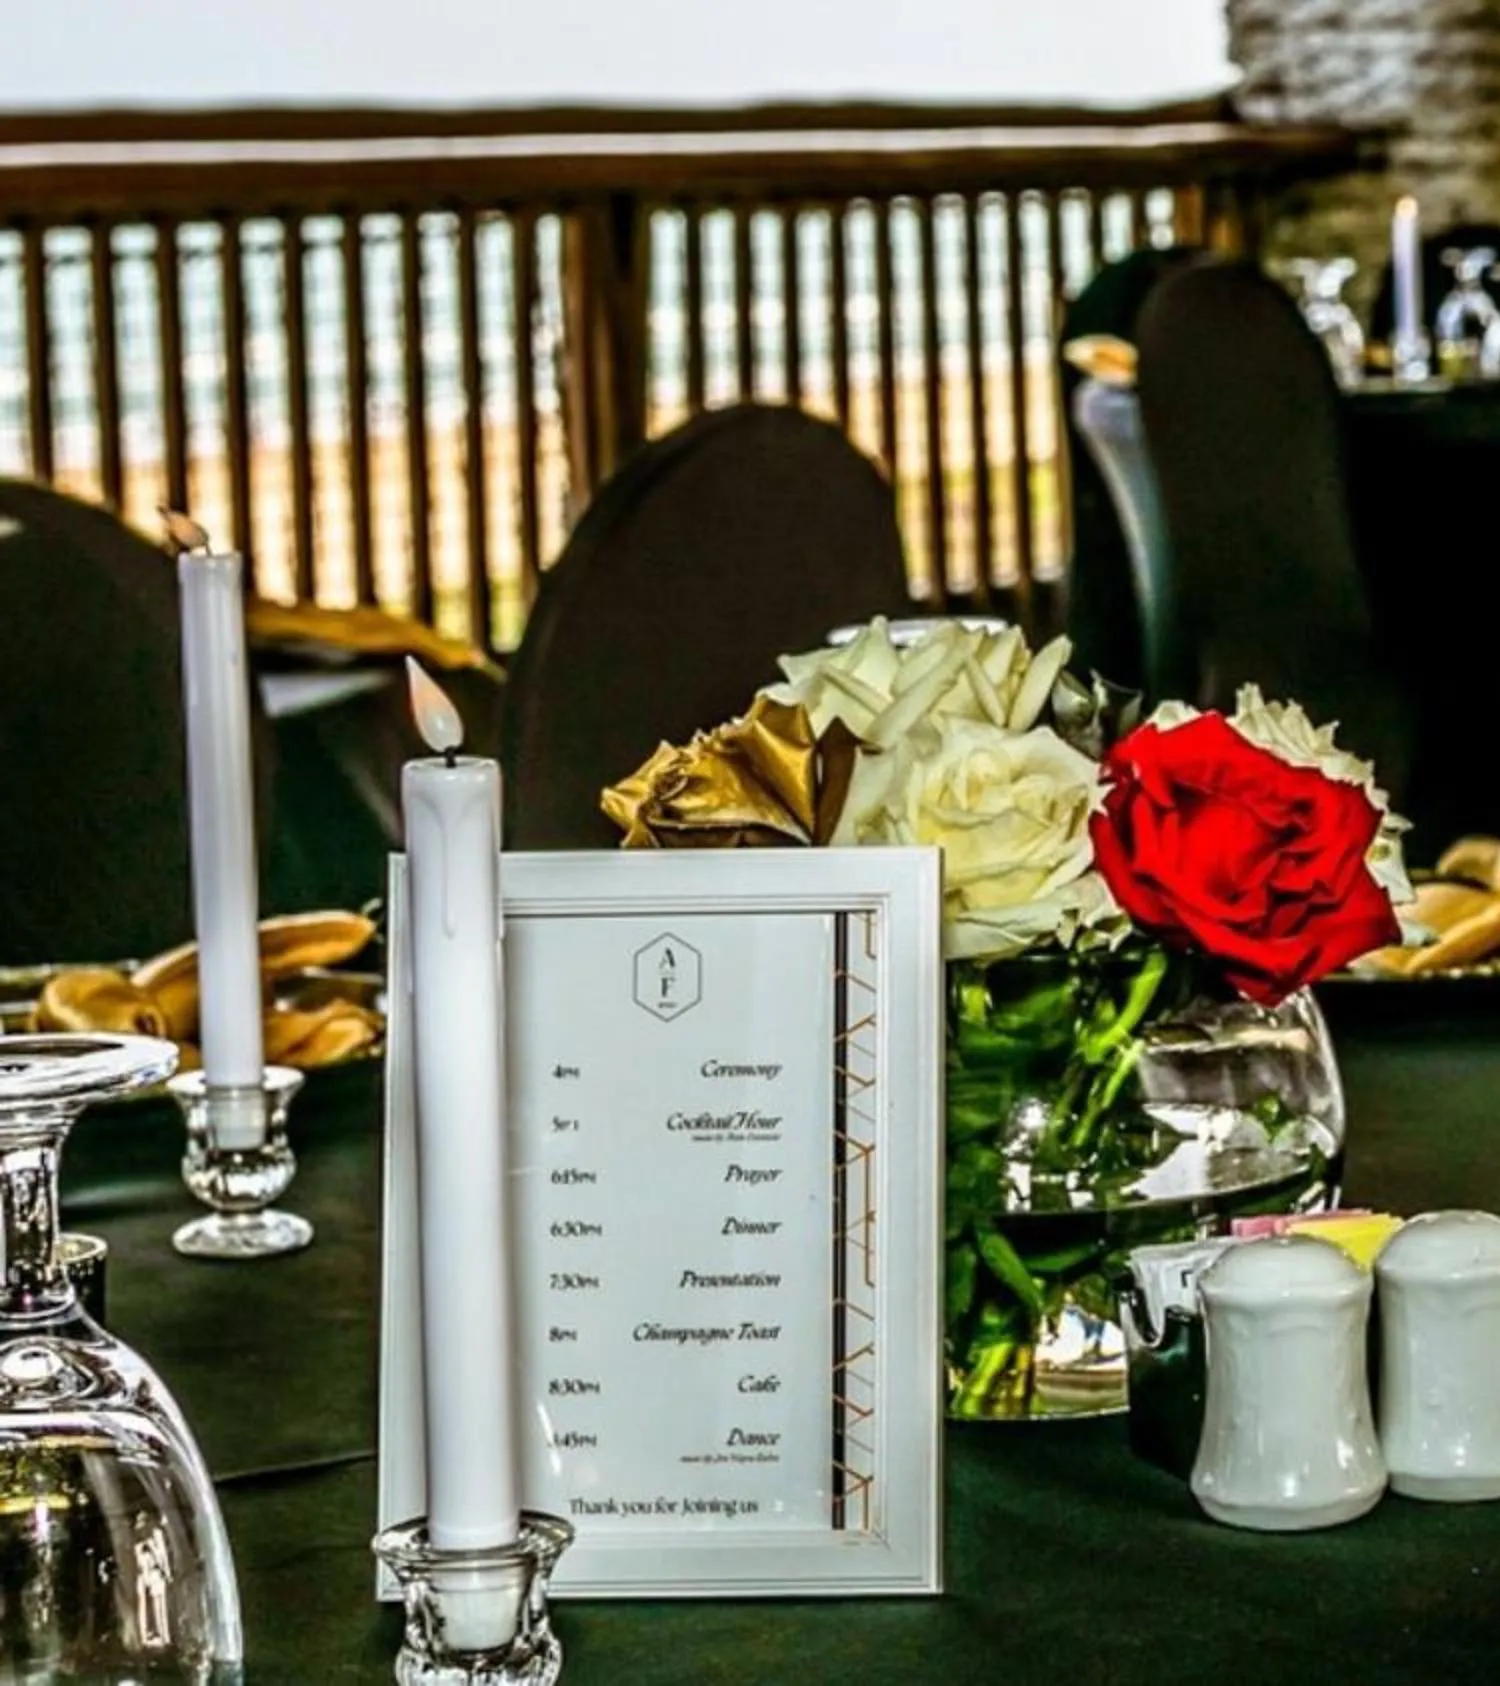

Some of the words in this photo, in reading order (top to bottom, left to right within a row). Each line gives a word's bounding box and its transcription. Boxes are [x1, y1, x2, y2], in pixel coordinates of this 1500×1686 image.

[659, 947, 676, 969] A
[700, 1059, 783, 1081] Ceremony
[666, 1111, 735, 1131] Cocktail
[734, 1110, 783, 1130] Hour
[724, 1164, 783, 1185] Prayer
[721, 1216, 783, 1236] Dinner
[679, 1269, 781, 1288] Presentation
[633, 1322, 734, 1346] Champagne
[738, 1322, 781, 1341] Toast
[737, 1373, 781, 1393] Cake
[726, 1427, 782, 1446] Dance
[569, 1496, 618, 1515] Thank
[620, 1501, 652, 1518] you
[654, 1496, 678, 1514] for
[741, 1500, 760, 1515] us
